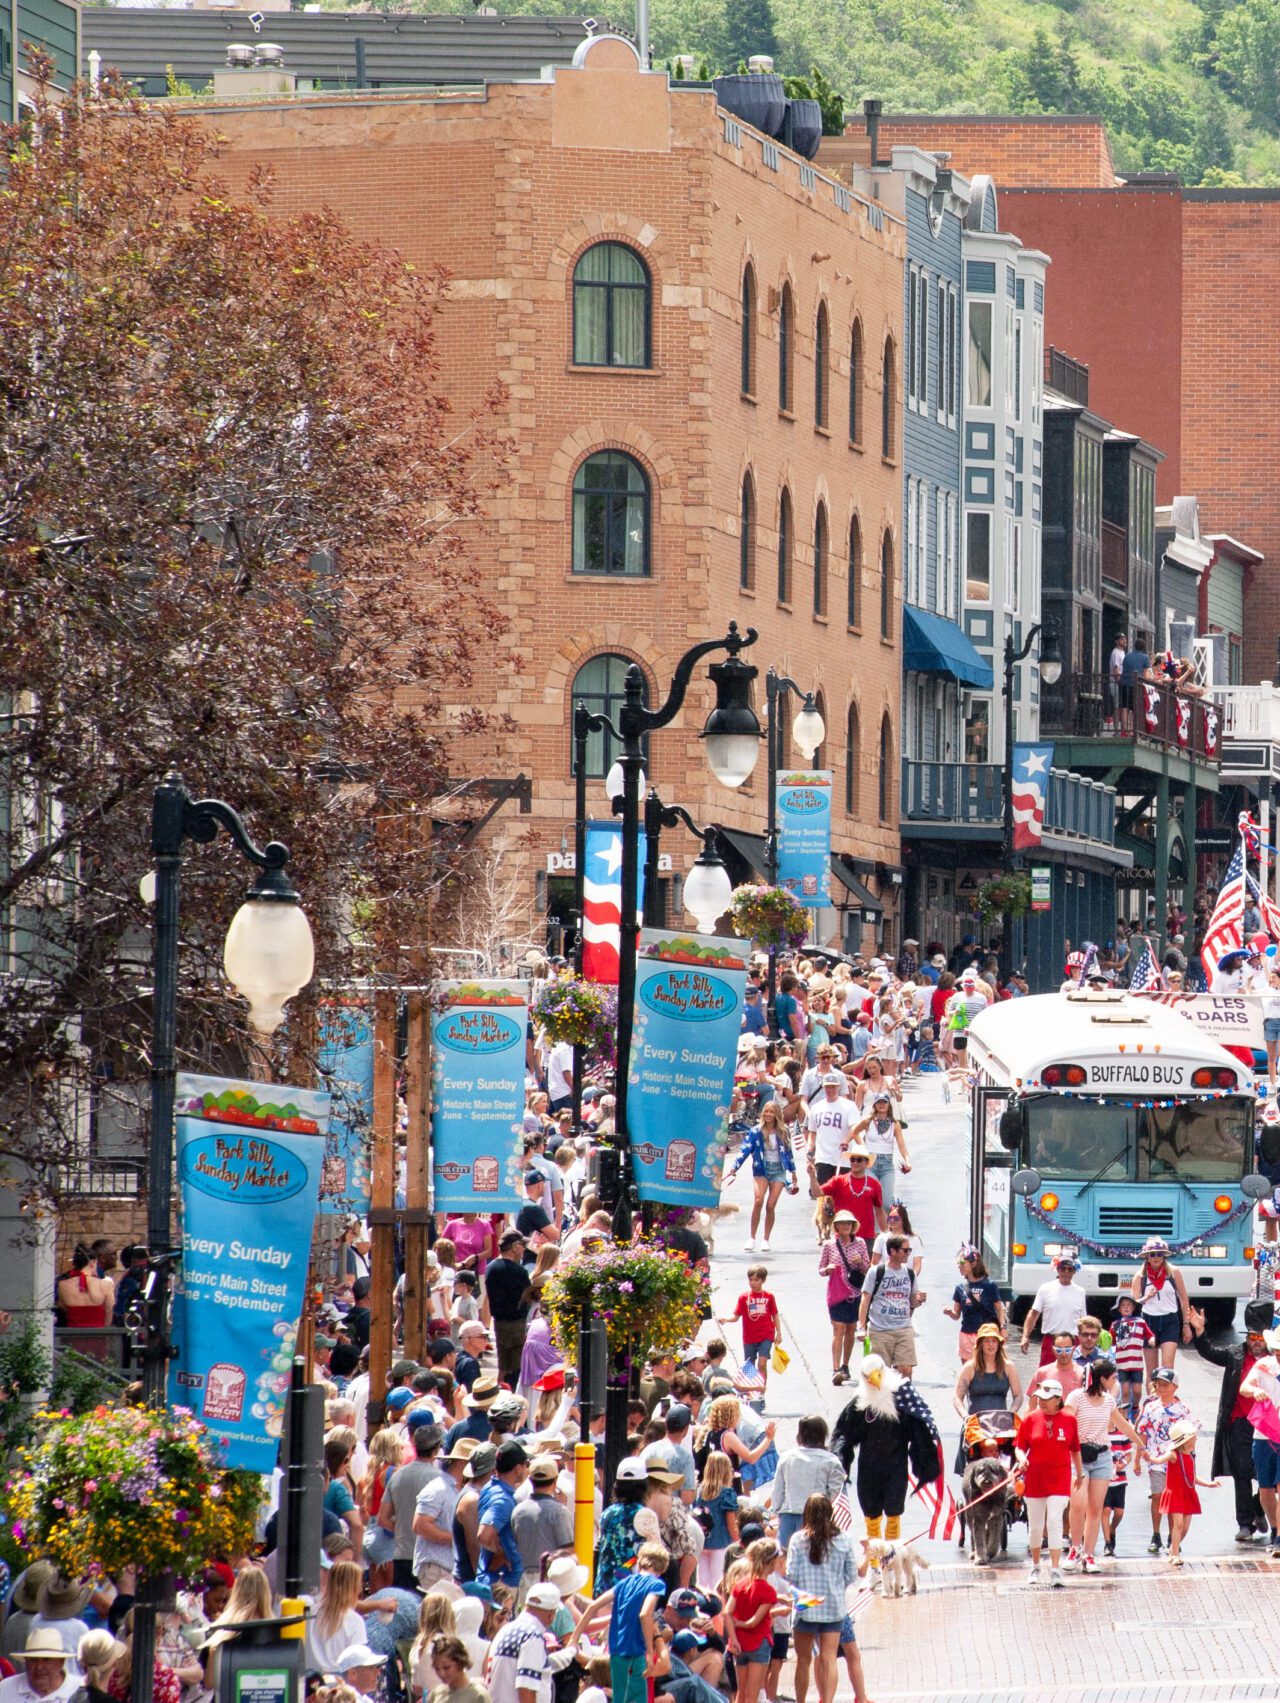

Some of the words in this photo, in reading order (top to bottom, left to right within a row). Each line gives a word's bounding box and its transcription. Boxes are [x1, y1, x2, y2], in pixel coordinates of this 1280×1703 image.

[784, 829, 801, 837] Every
[803, 828, 827, 837] Sunday
[668, 973, 689, 990] Park
[692, 974, 713, 997] Silly
[654, 985, 687, 1011] Sunday
[688, 989, 725, 1010] Market
[460, 1015, 479, 1028] Park
[480, 1014, 499, 1032] Silly
[448, 1027, 478, 1046] Sunday
[479, 1030, 510, 1043] Market
[643, 1044, 678, 1063] Every
[681, 1048, 727, 1069] Sunday
[642, 1069, 673, 1083] Historic
[675, 1073, 695, 1086] Main
[697, 1076, 724, 1090] Street
[1091, 1065, 1149, 1083] BUFFALO
[1152, 1066, 1184, 1085] BUS
[443, 1078, 474, 1092] Every
[476, 1078, 517, 1092] Sunday
[641, 1083, 661, 1094] June
[670, 1086, 723, 1102] September
[442, 1099, 472, 1110] Historic
[473, 1099, 493, 1110] Main
[494, 1100, 517, 1110] Street
[442, 1111, 462, 1120] June
[471, 1110, 516, 1122] September
[815, 1111, 842, 1129] USA
[215, 1138, 244, 1161] Park
[247, 1139, 275, 1171] Silly
[194, 1152, 241, 1191] Sunday
[241, 1163, 290, 1188] Market
[992, 1182, 1006, 1193] 44
[181, 1232, 225, 1260] Every
[228, 1240, 292, 1269] Sunday
[219, 1273, 248, 1292] Main
[250, 1278, 288, 1297] Street
[213, 1289, 285, 1314] September
[884, 1291, 904, 1299] RED
[888, 1307, 907, 1316] BLUE
